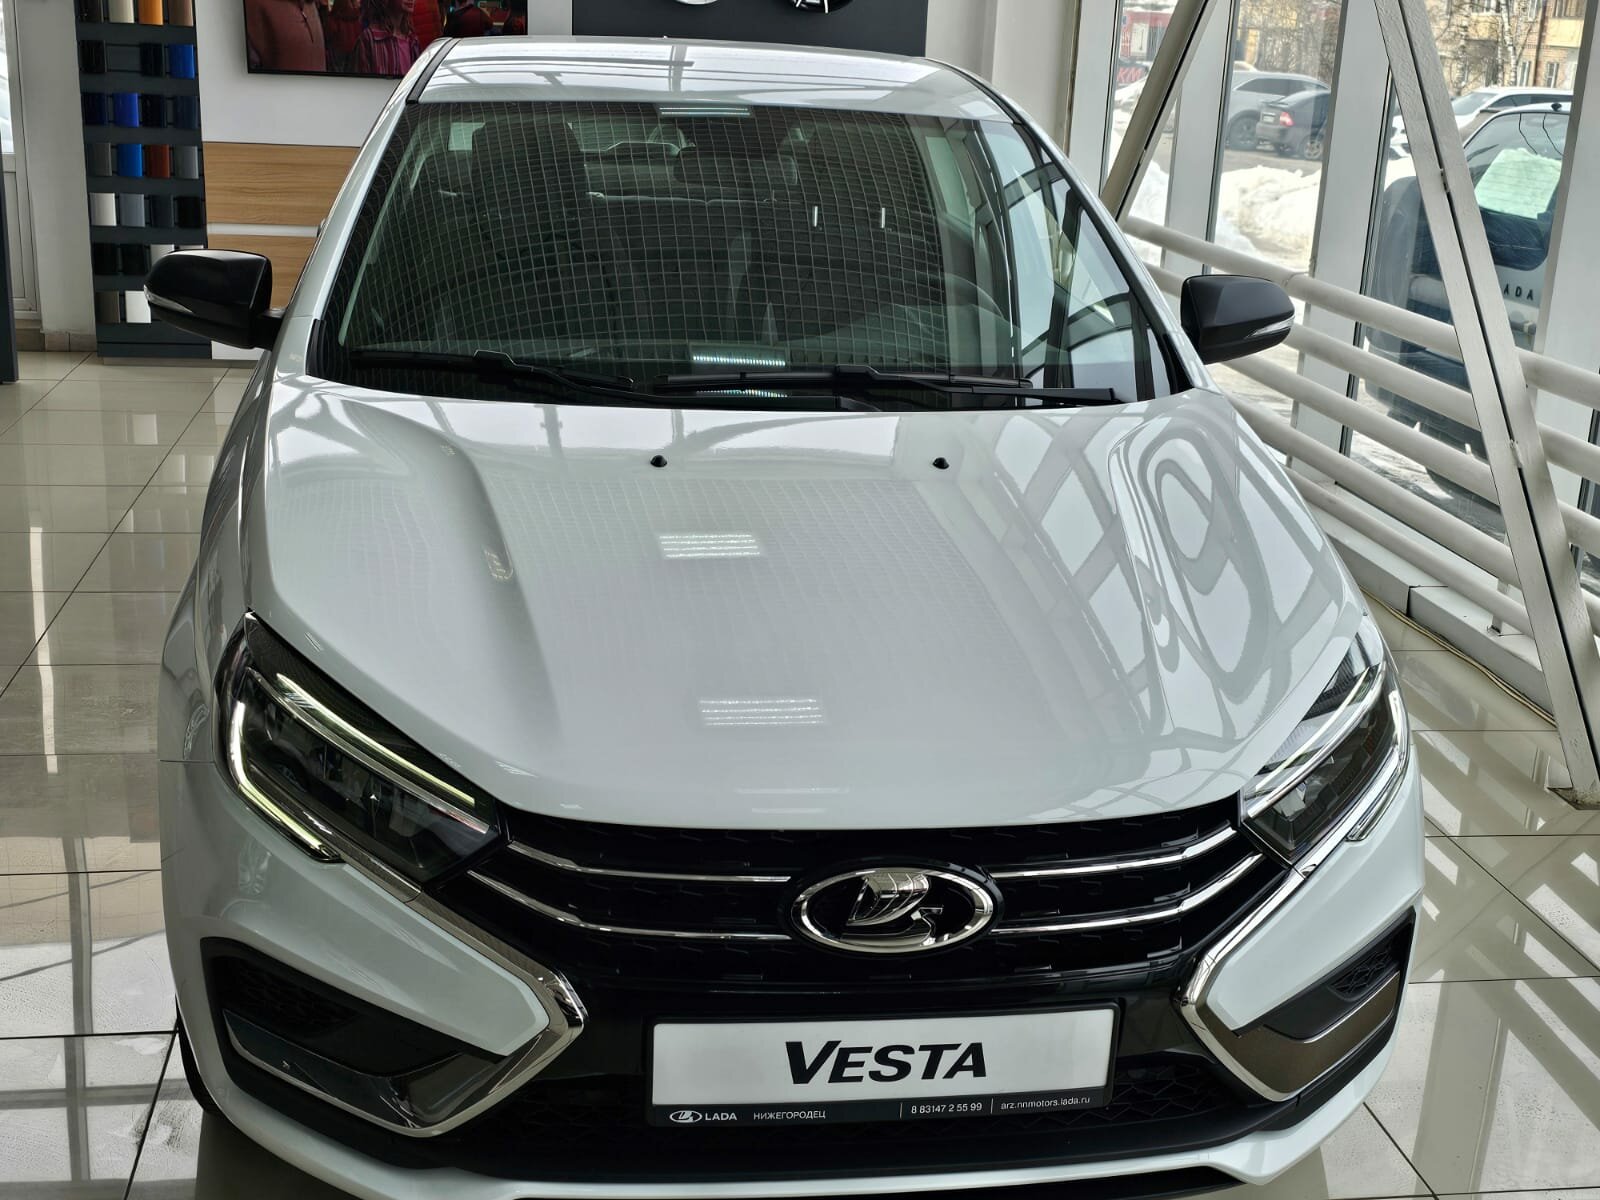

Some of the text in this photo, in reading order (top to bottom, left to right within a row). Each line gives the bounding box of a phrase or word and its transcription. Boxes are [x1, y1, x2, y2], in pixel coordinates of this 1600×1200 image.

[1503, 283, 1534, 301] ADA
[784, 1040, 987, 1085] VESTA
[1000, 1096, 1091, 1110] arz.nnmotors.lada.ru
[704, 1112, 738, 1121] LADA
[753, 1110, 826, 1120] НИЖЕГОРОДЕЦ
